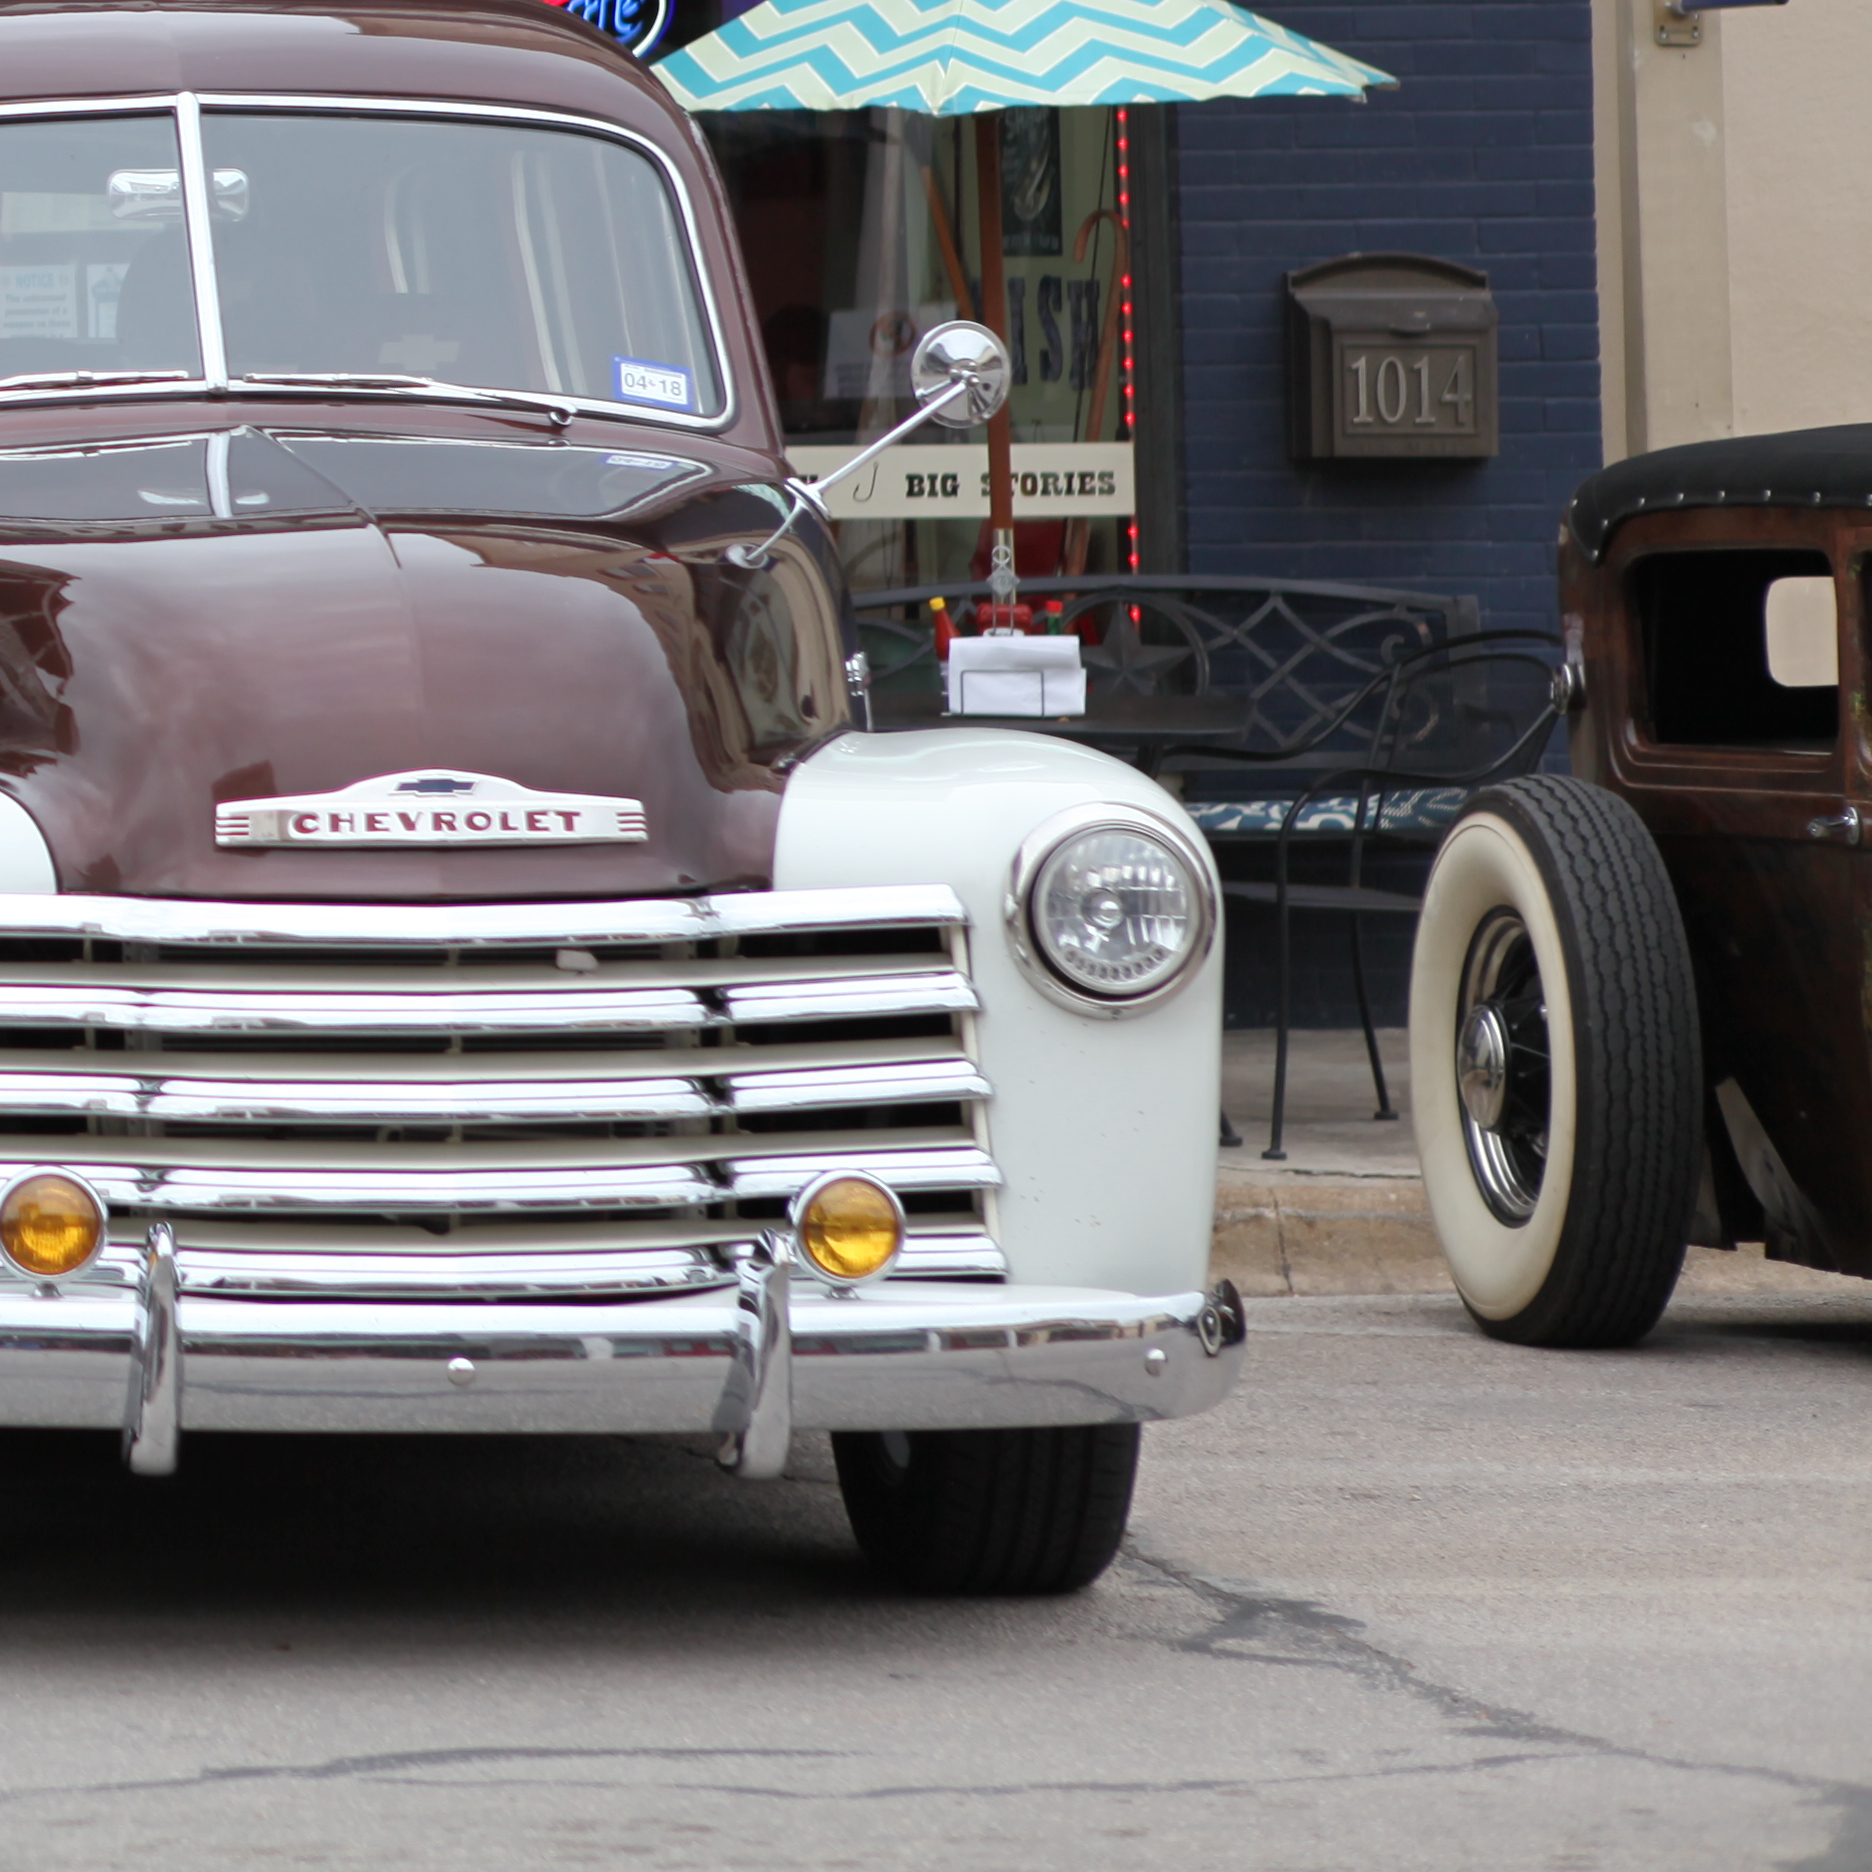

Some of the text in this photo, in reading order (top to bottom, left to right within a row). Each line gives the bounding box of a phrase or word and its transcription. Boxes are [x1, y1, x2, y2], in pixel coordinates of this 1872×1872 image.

[972, 274, 1101, 391] ISH
[624, 372, 683, 397] 04 18
[1350, 354, 1473, 426] 1014
[905, 472, 960, 499] BIG
[292, 809, 583, 834] CHEVROLET
